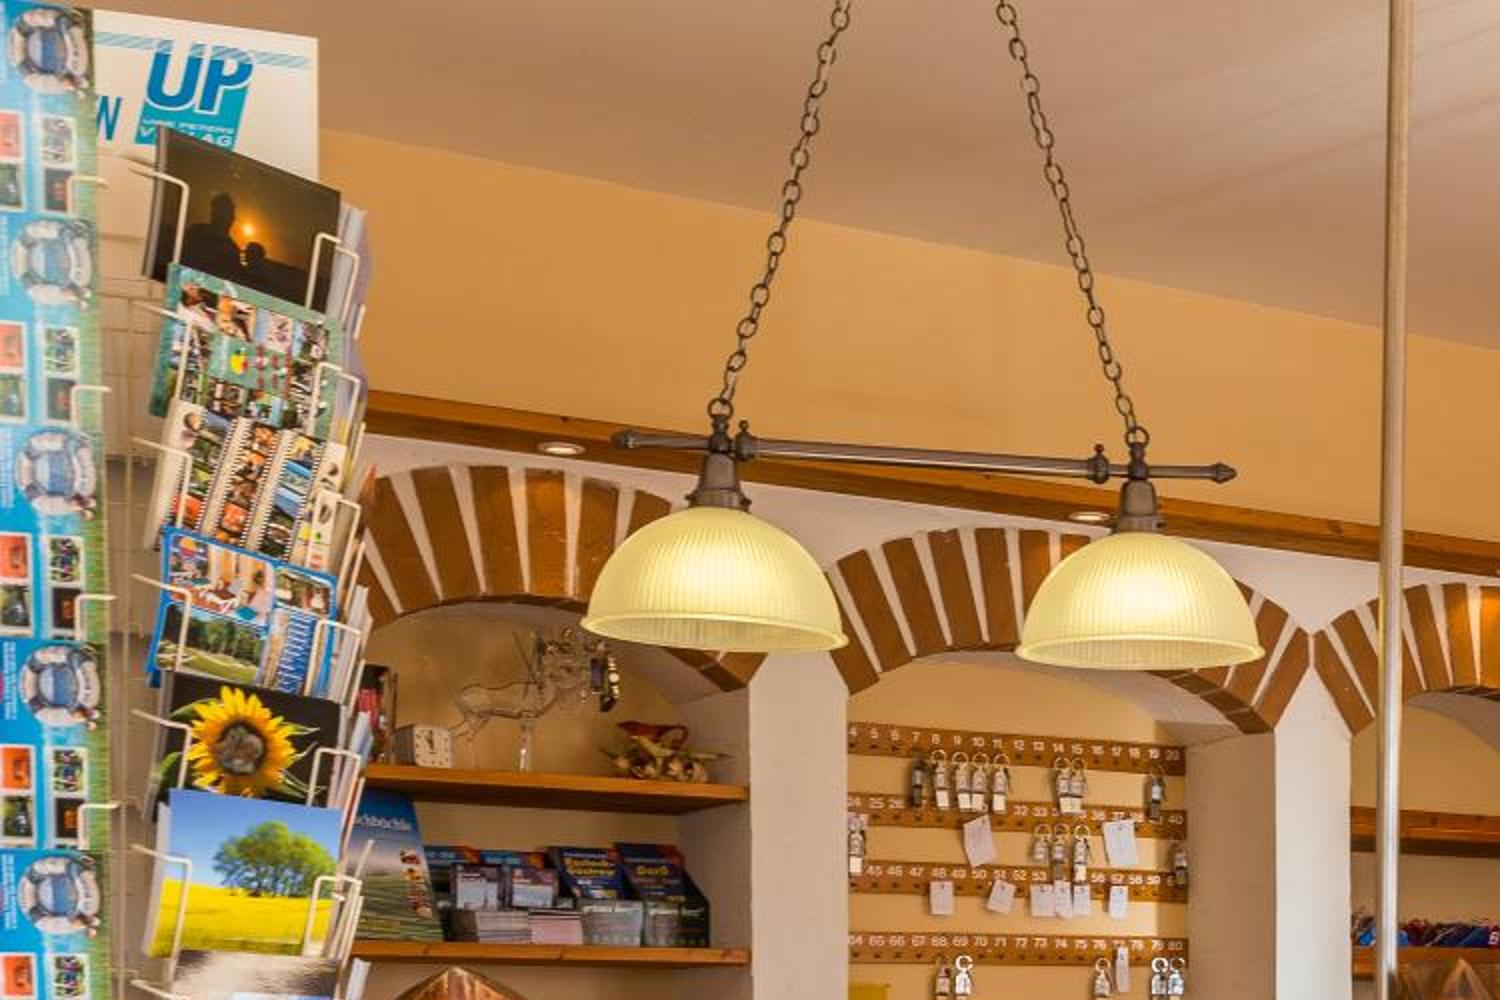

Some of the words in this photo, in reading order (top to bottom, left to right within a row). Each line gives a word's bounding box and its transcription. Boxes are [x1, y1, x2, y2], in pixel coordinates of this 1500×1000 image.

[147, 39, 253, 112] UP
[870, 727, 878, 739] 5
[912, 731, 921, 743] 7
[931, 734, 941, 745] 8
[972, 737, 985, 747] 10
[1052, 743, 1064, 753] 14
[1071, 744, 1083, 755] 15
[908, 867, 924, 877] 47
[972, 869, 987, 880] 50
[975, 936, 988, 947] 70
[994, 937, 1007, 947] 71
